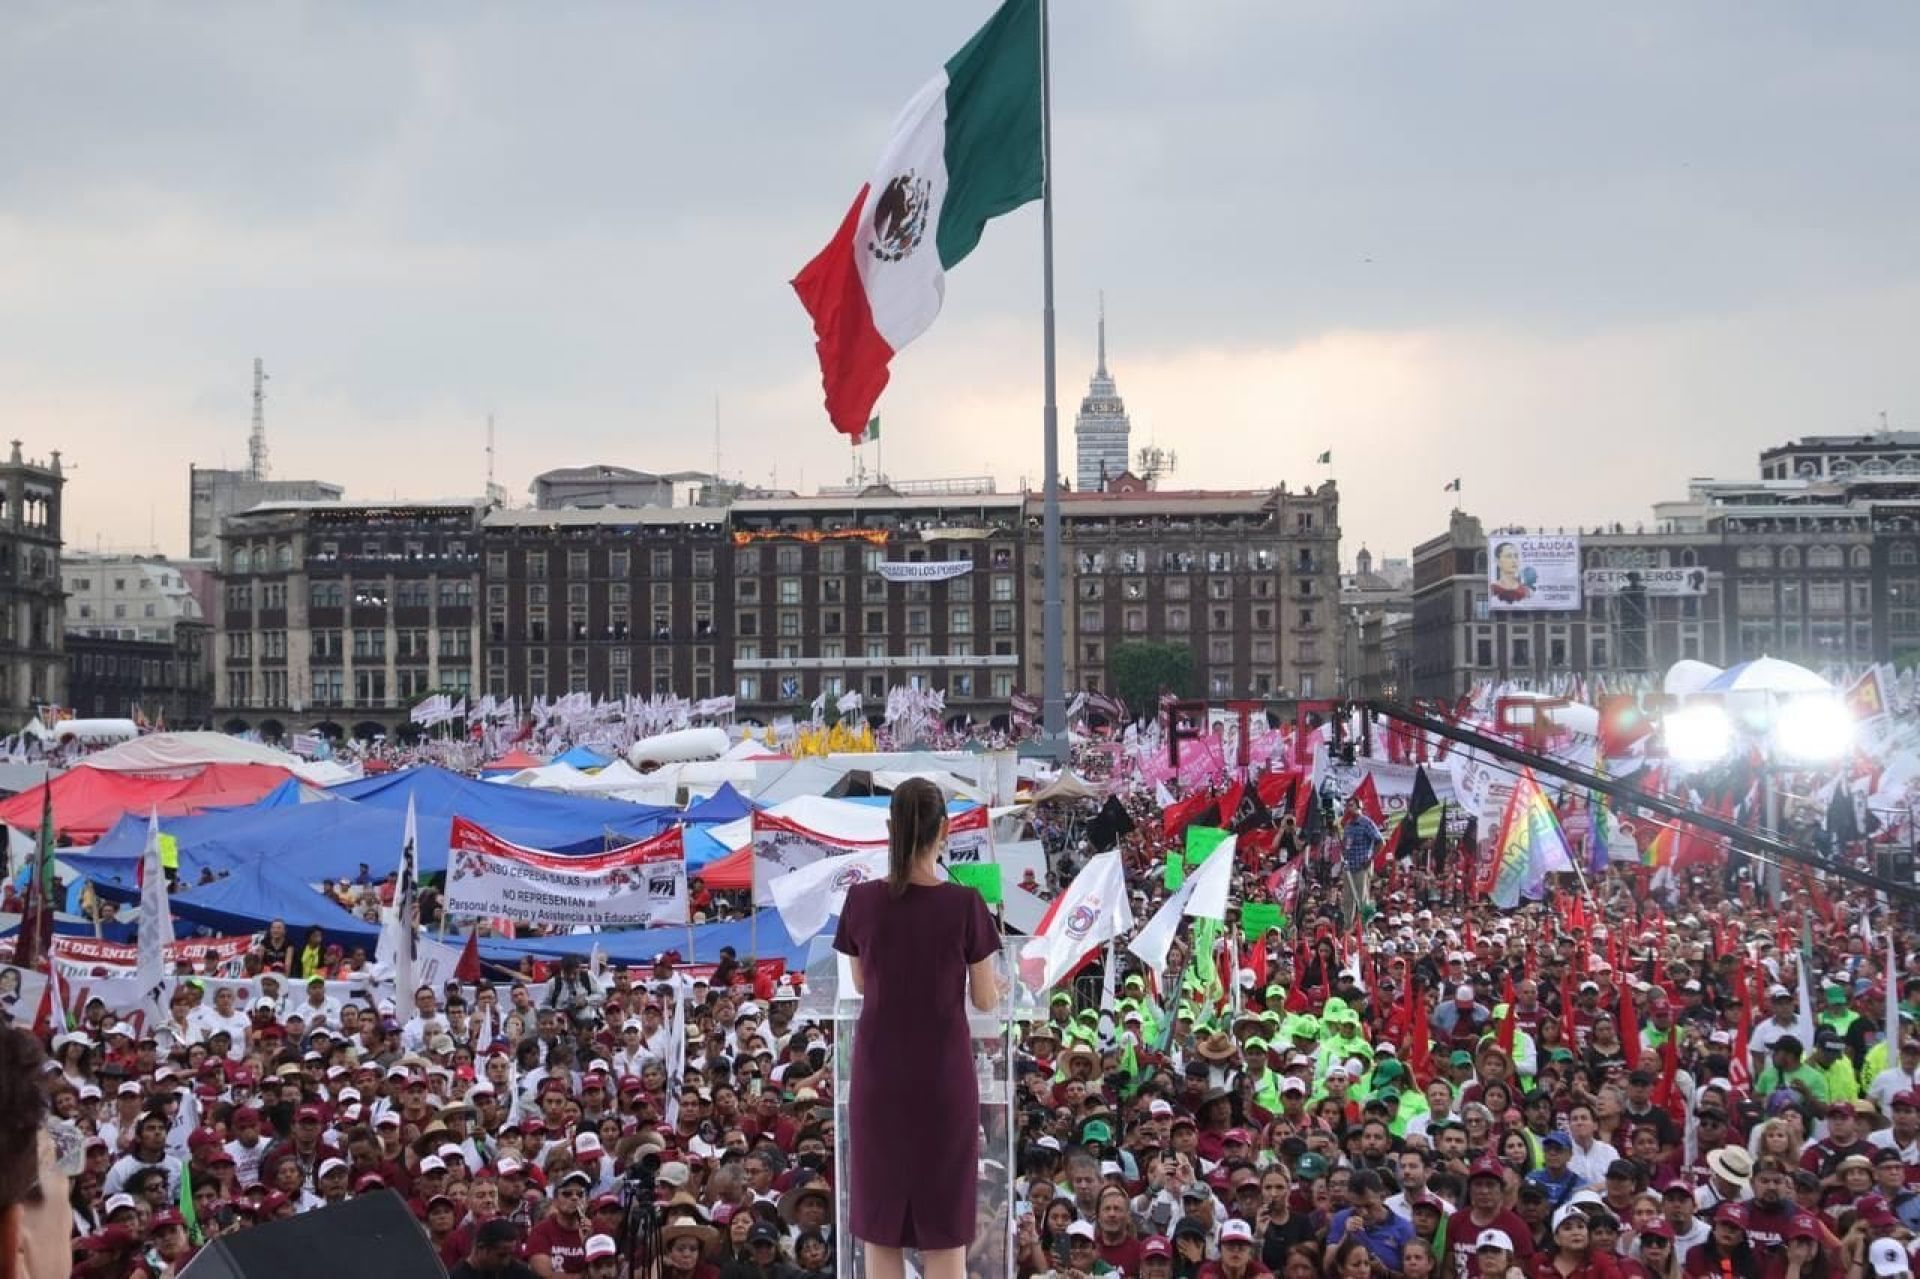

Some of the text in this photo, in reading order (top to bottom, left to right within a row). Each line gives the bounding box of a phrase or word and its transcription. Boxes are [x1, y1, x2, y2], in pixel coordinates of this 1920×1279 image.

[1520, 541, 1575, 551] CLAUDIA
[548, 873, 580, 886] SALAS
[503, 887, 516, 900] NO
[517, 890, 586, 908] REPRESENTAN
[449, 897, 488, 912] Personal
[502, 904, 529, 920] Apoyo
[539, 907, 584, 921] Asistencia
[71, 941, 100, 957] DEL
